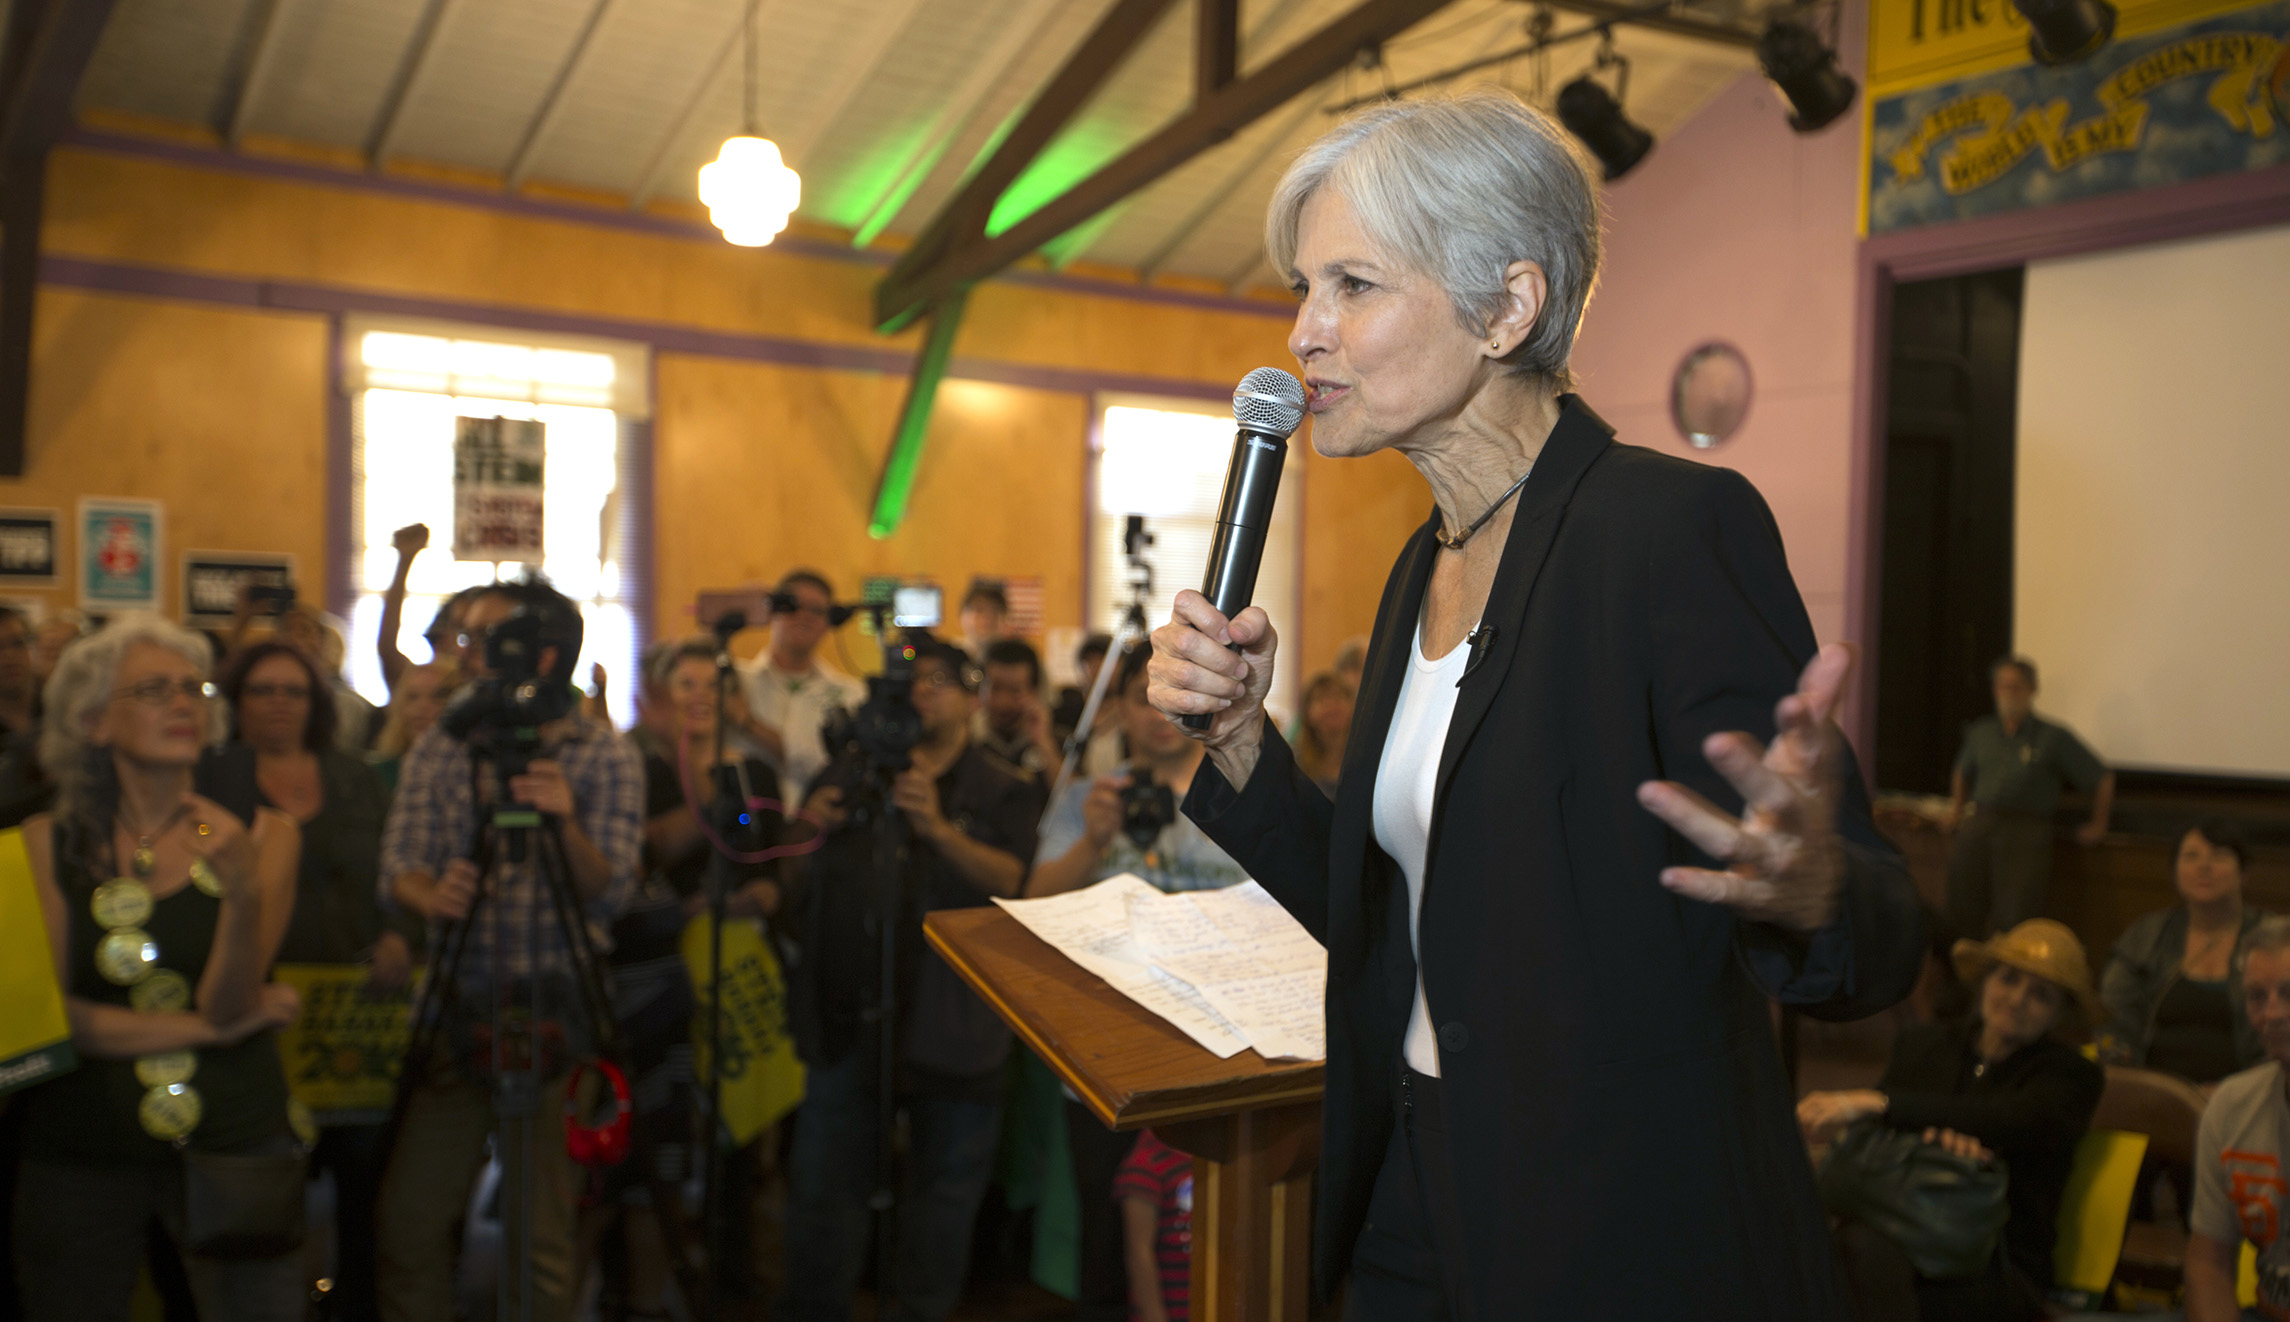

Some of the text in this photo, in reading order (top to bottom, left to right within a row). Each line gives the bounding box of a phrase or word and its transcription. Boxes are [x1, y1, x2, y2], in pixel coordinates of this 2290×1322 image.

[2116, 34, 2255, 95] COUNTRY
[1949, 121, 2035, 184] WORLD
[2053, 121, 2128, 163] IS MY
